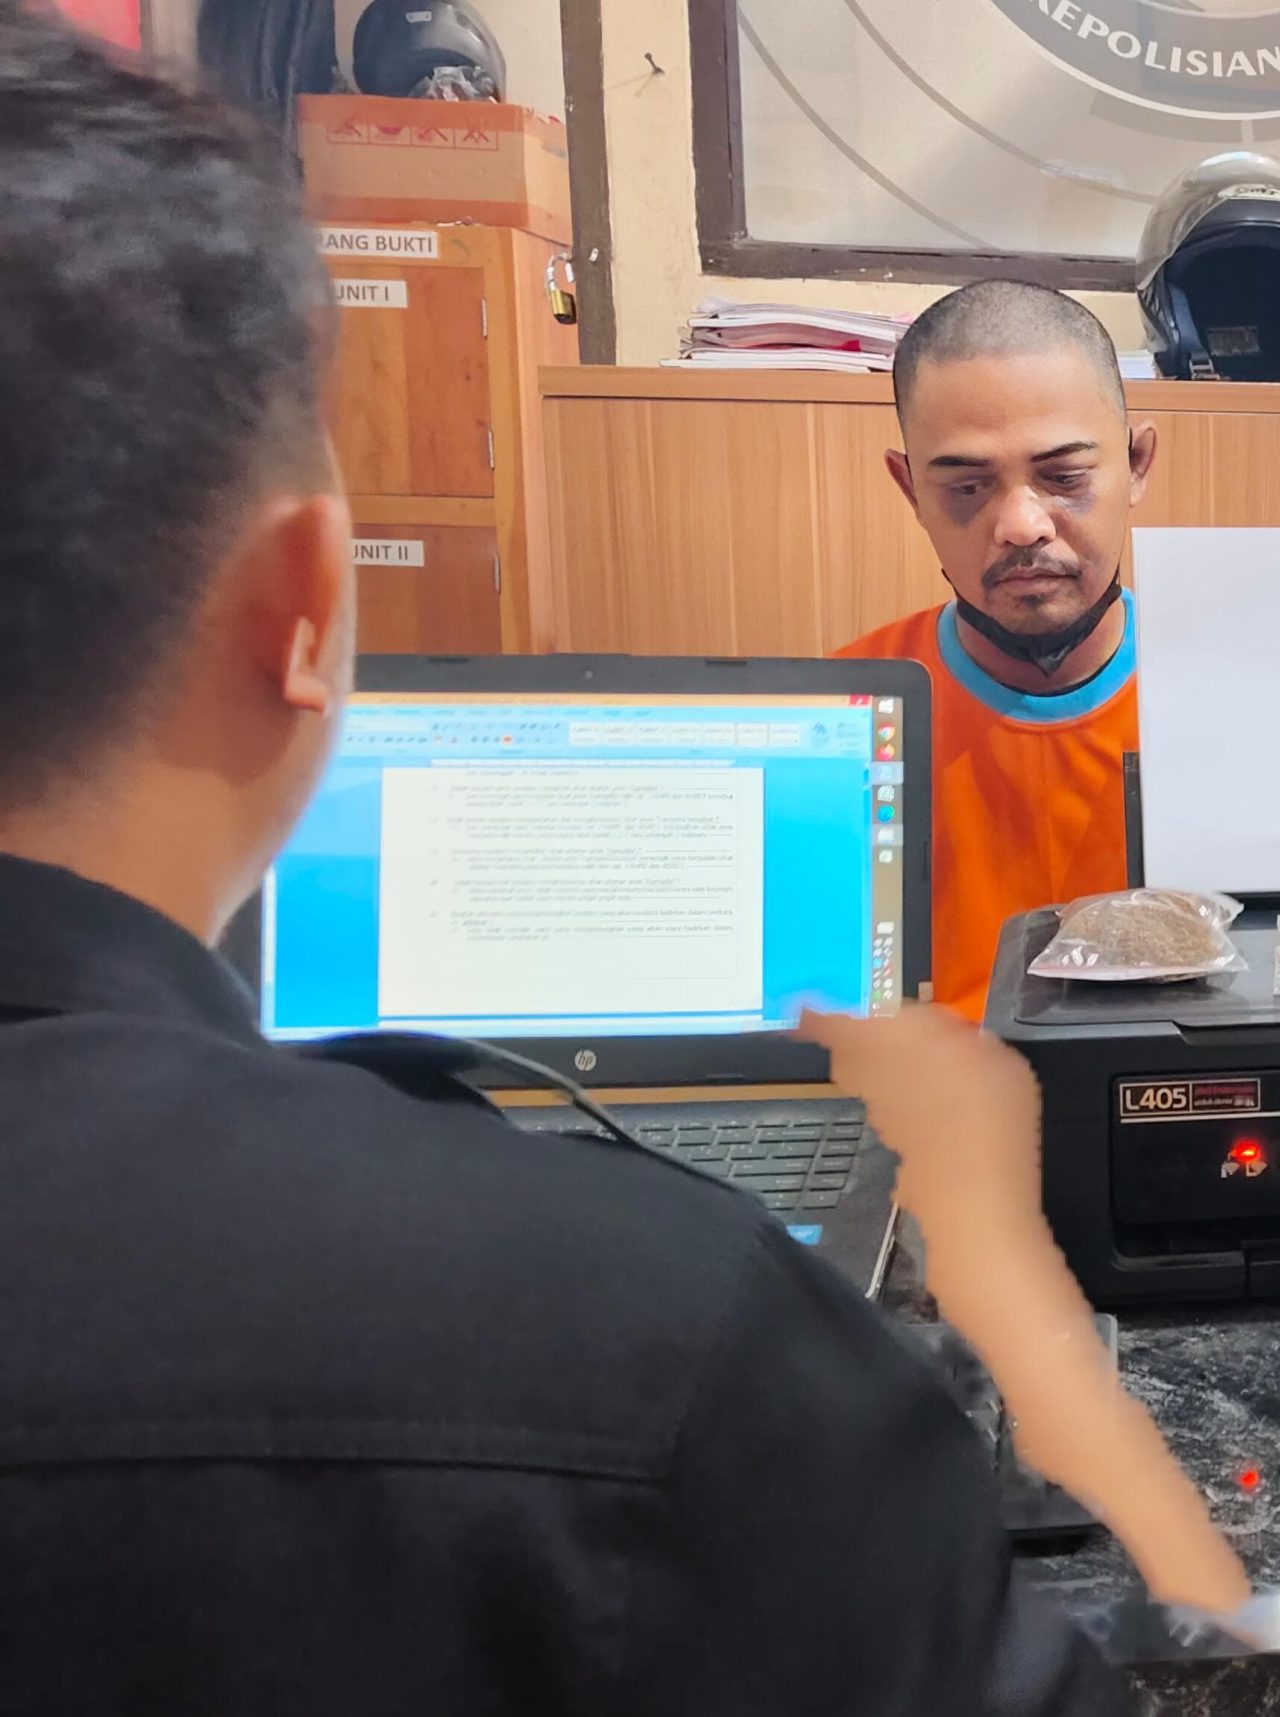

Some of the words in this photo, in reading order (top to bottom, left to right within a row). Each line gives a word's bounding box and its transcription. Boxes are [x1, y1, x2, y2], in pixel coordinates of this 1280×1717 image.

[316, 232, 369, 251] RANG
[375, 235, 432, 252] BUKTI
[398, 545, 408, 560] II
[1125, 1087, 1187, 1111] L405
